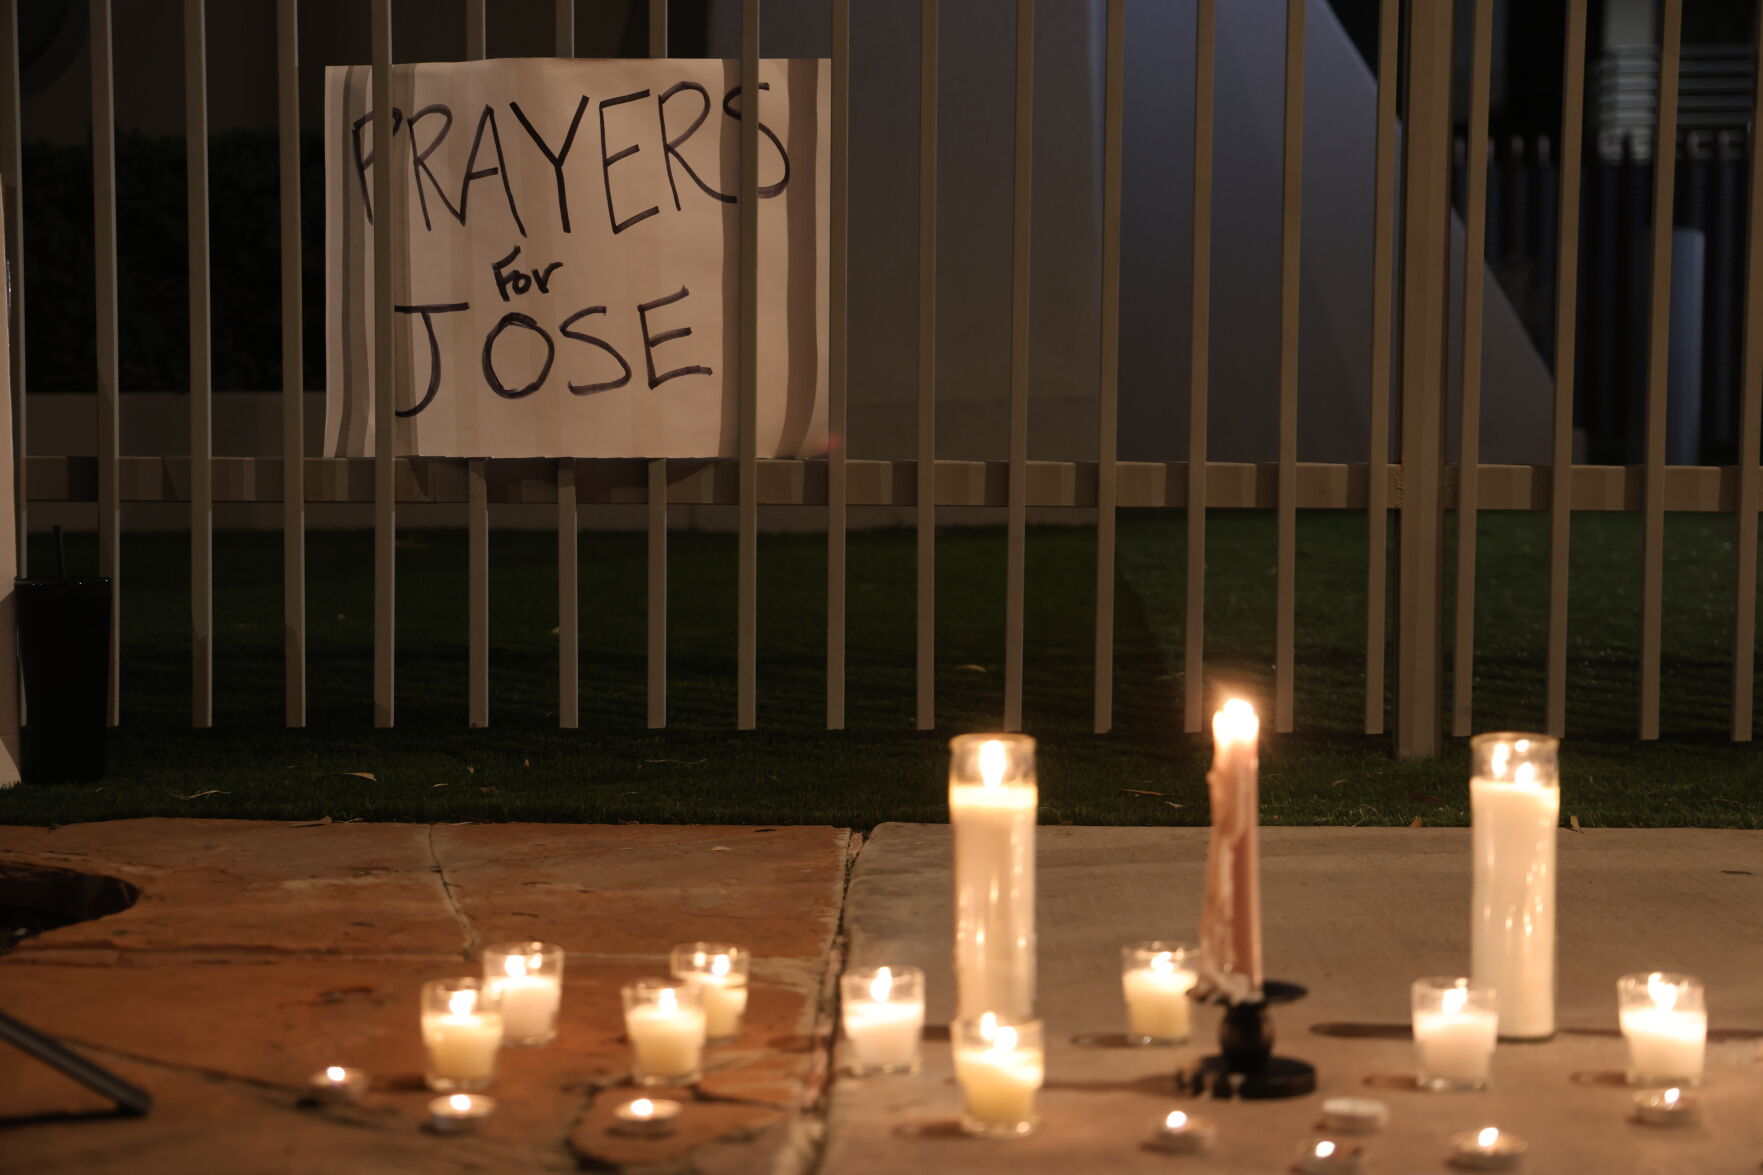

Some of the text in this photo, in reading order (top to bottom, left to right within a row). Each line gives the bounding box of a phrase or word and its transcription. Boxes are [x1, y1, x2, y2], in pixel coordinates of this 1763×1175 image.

[353, 81, 790, 238] PRAYERS
[492, 245, 563, 302] For
[395, 285, 713, 418] JOSE
